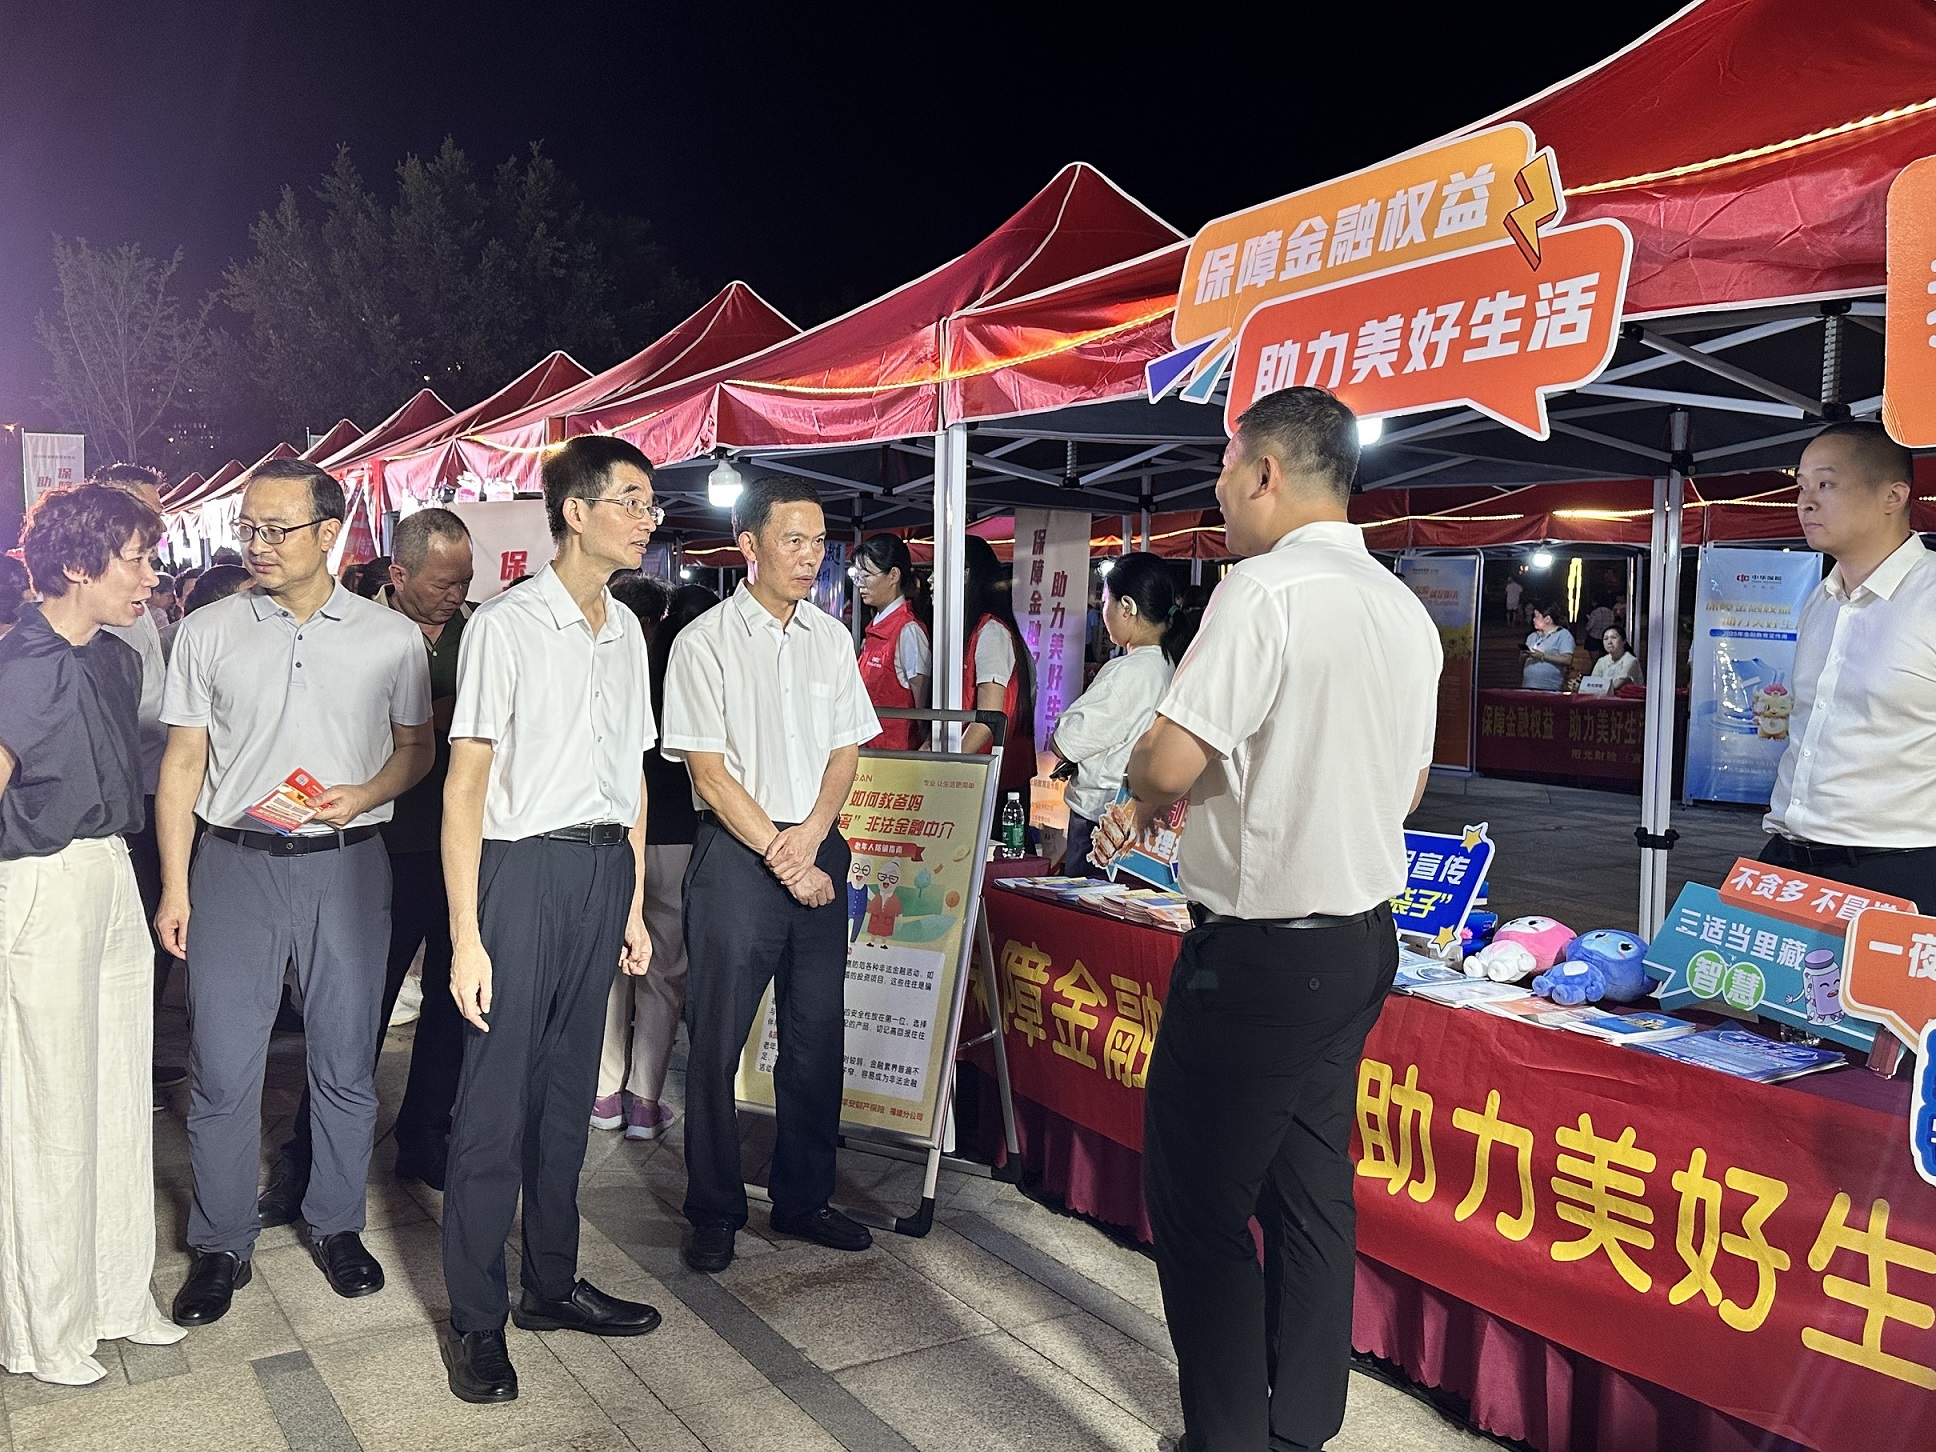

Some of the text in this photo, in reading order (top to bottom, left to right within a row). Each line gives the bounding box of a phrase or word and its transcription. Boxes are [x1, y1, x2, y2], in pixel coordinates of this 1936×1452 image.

[1195, 162, 1497, 304] 保障金融权益
[1252, 272, 1600, 401] 助力美好生活
[500, 551, 528, 581] 保
[1482, 704, 1554, 740] 保障金融权益
[849, 789, 924, 812] 如何教爸妈
[1730, 866, 1809, 903] 不贪多
[1675, 907, 1808, 972] 三适当里藏
[1691, 956, 1762, 1006] 智慧
[1356, 1057, 1936, 1391] 助力美好生
